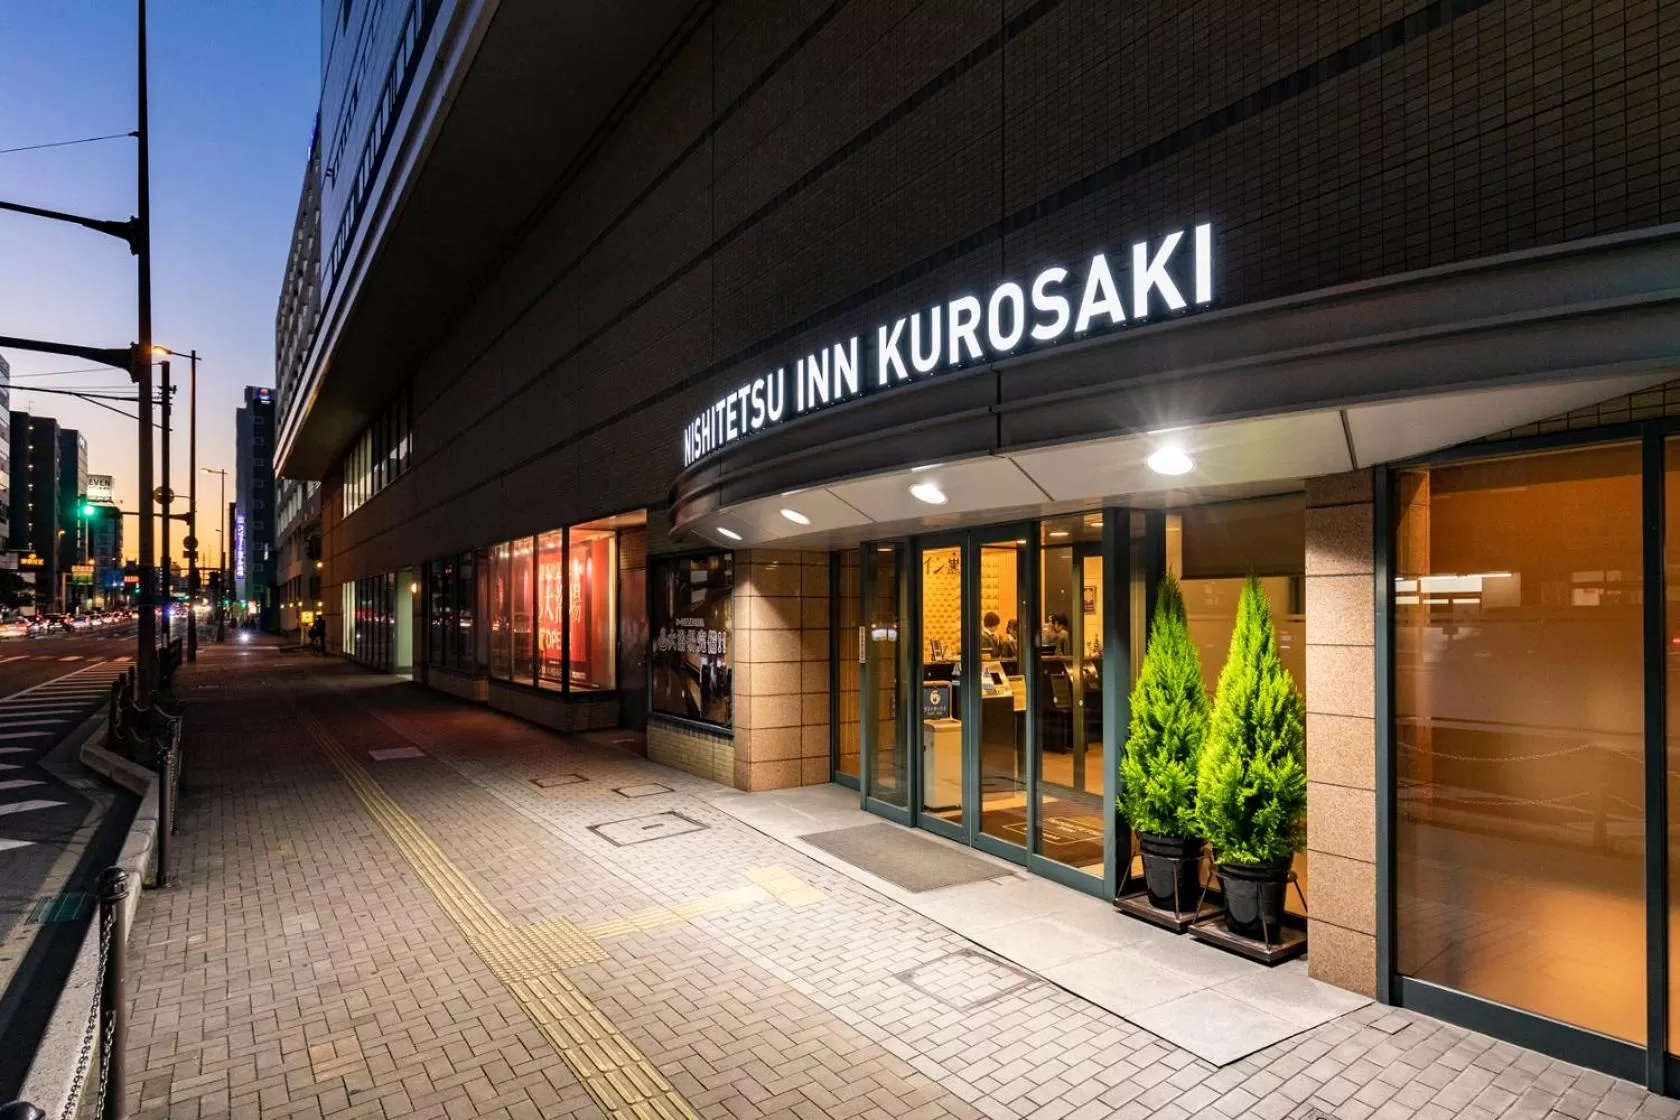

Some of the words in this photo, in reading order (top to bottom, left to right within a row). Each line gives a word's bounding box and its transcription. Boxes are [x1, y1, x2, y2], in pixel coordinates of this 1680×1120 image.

[684, 367, 784, 468] NISHITETSU
[796, 336, 858, 412] INN
[877, 223, 1213, 385] KUROSAKI
